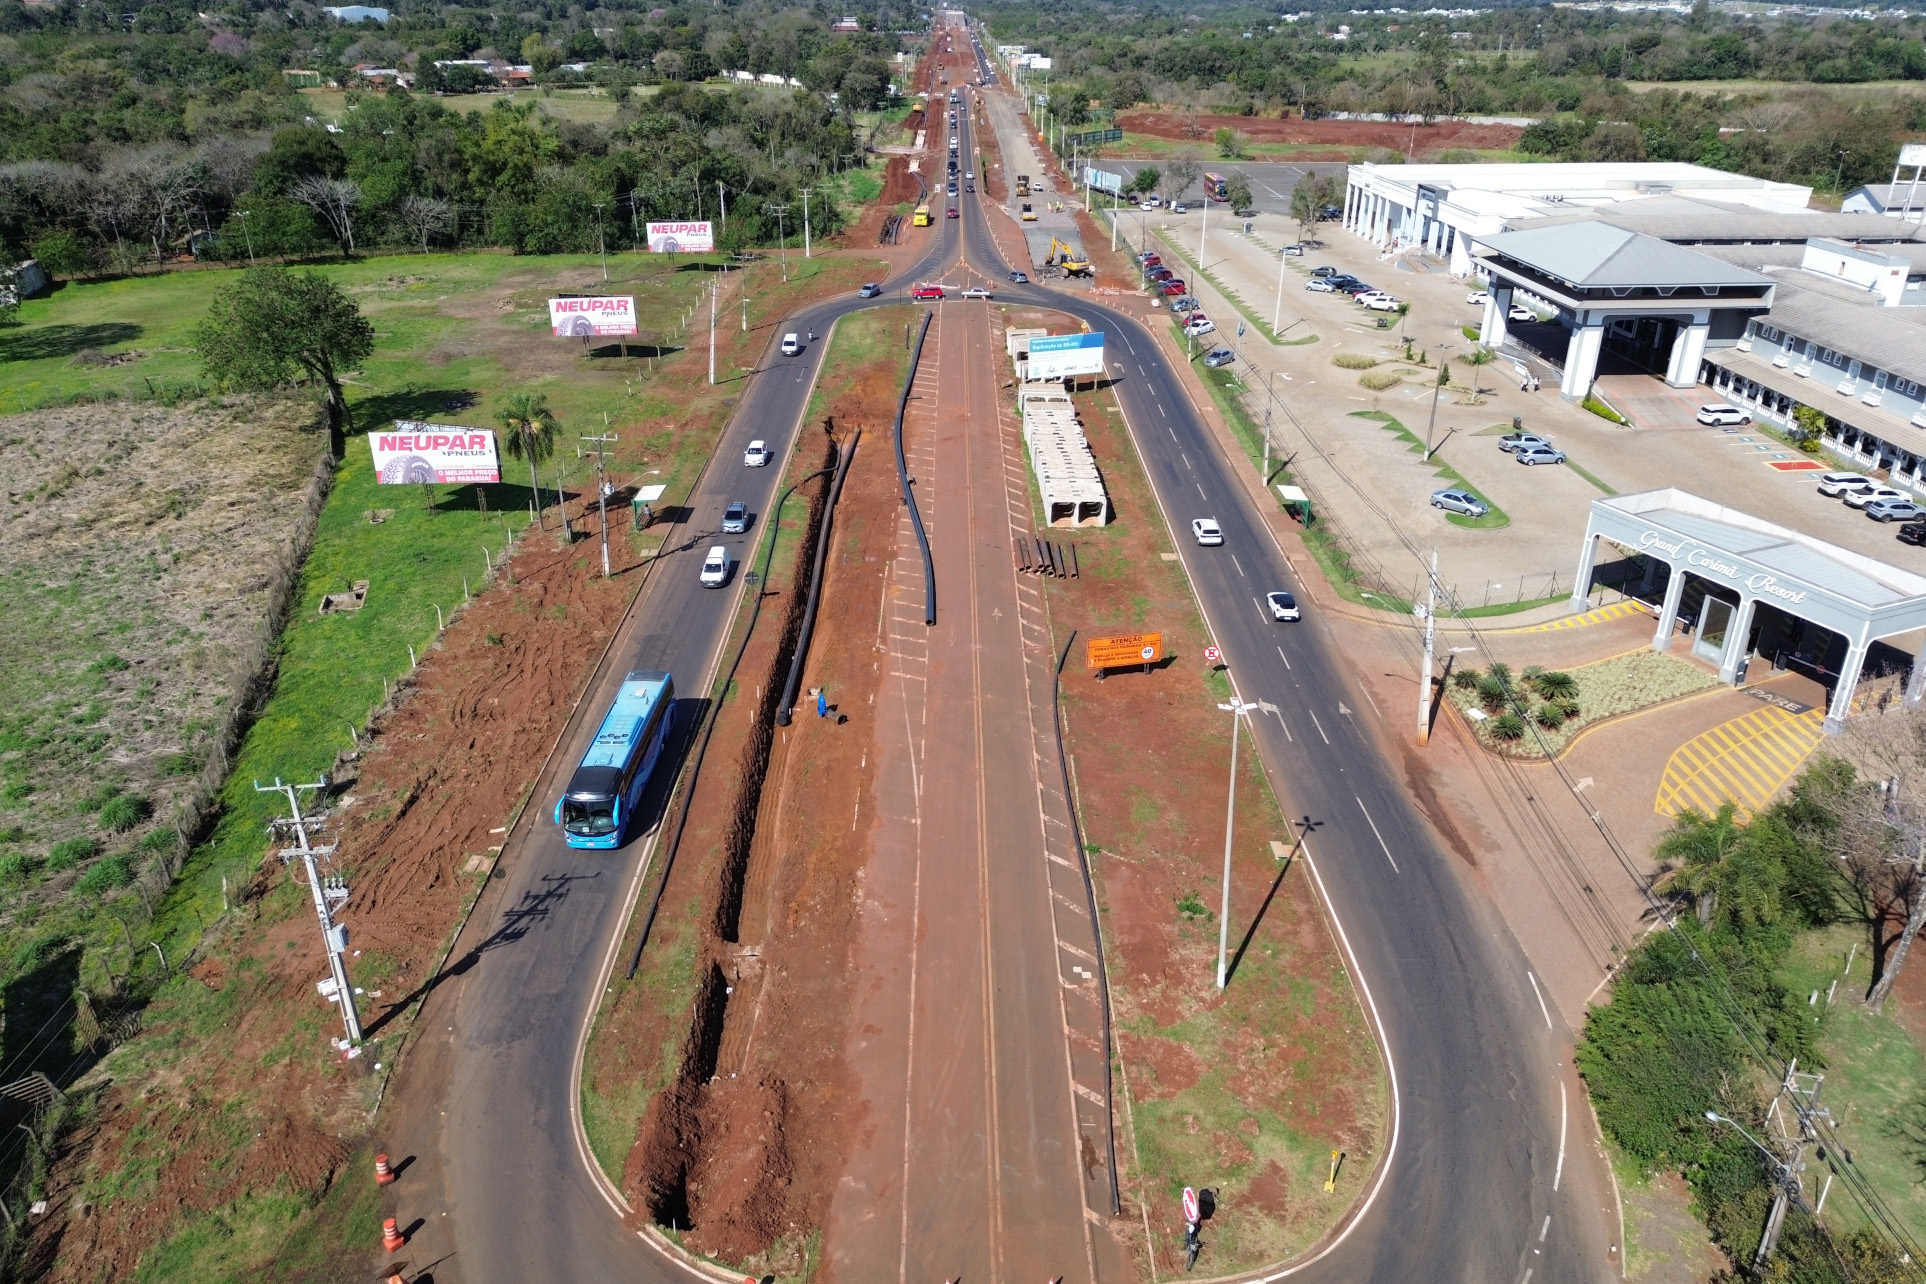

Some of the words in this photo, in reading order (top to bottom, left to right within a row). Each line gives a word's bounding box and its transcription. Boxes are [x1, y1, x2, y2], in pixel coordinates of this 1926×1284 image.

[652, 224, 708, 234] NEUPAR
[556, 300, 629, 312] NEUPAR
[379, 434, 486, 451] NEUPAR
[1632, 530, 1696, 560] Grand
[1745, 573, 1807, 605] Resort
[1111, 636, 1142, 644] ATENÇÃO
[1748, 686, 1802, 712] PARE
